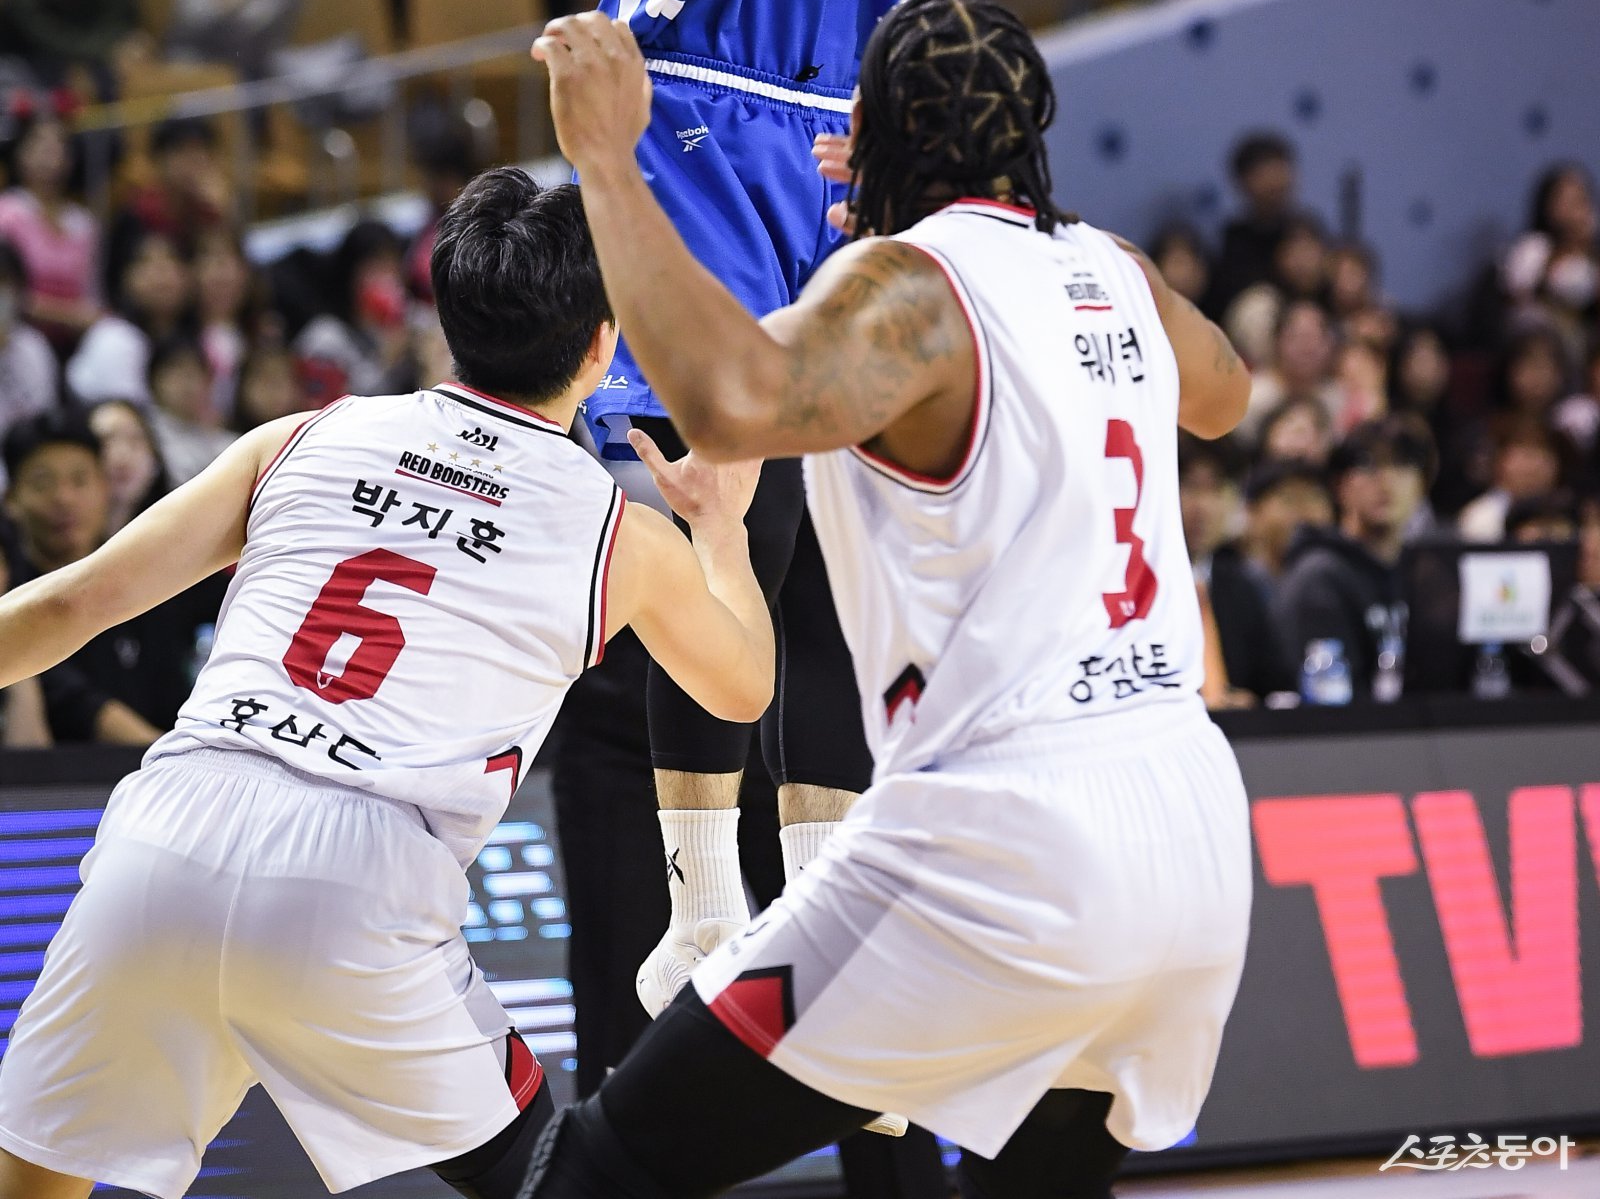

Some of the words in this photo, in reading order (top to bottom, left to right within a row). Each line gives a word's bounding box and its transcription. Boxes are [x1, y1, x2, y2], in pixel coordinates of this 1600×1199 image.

[352, 479, 505, 564] 박지훈
[398, 451, 431, 476] RED
[430, 463, 510, 500] BOOSTERS
[1101, 418, 1158, 629] 3
[282, 547, 438, 705] 6
[1252, 781, 1600, 1070] TV
